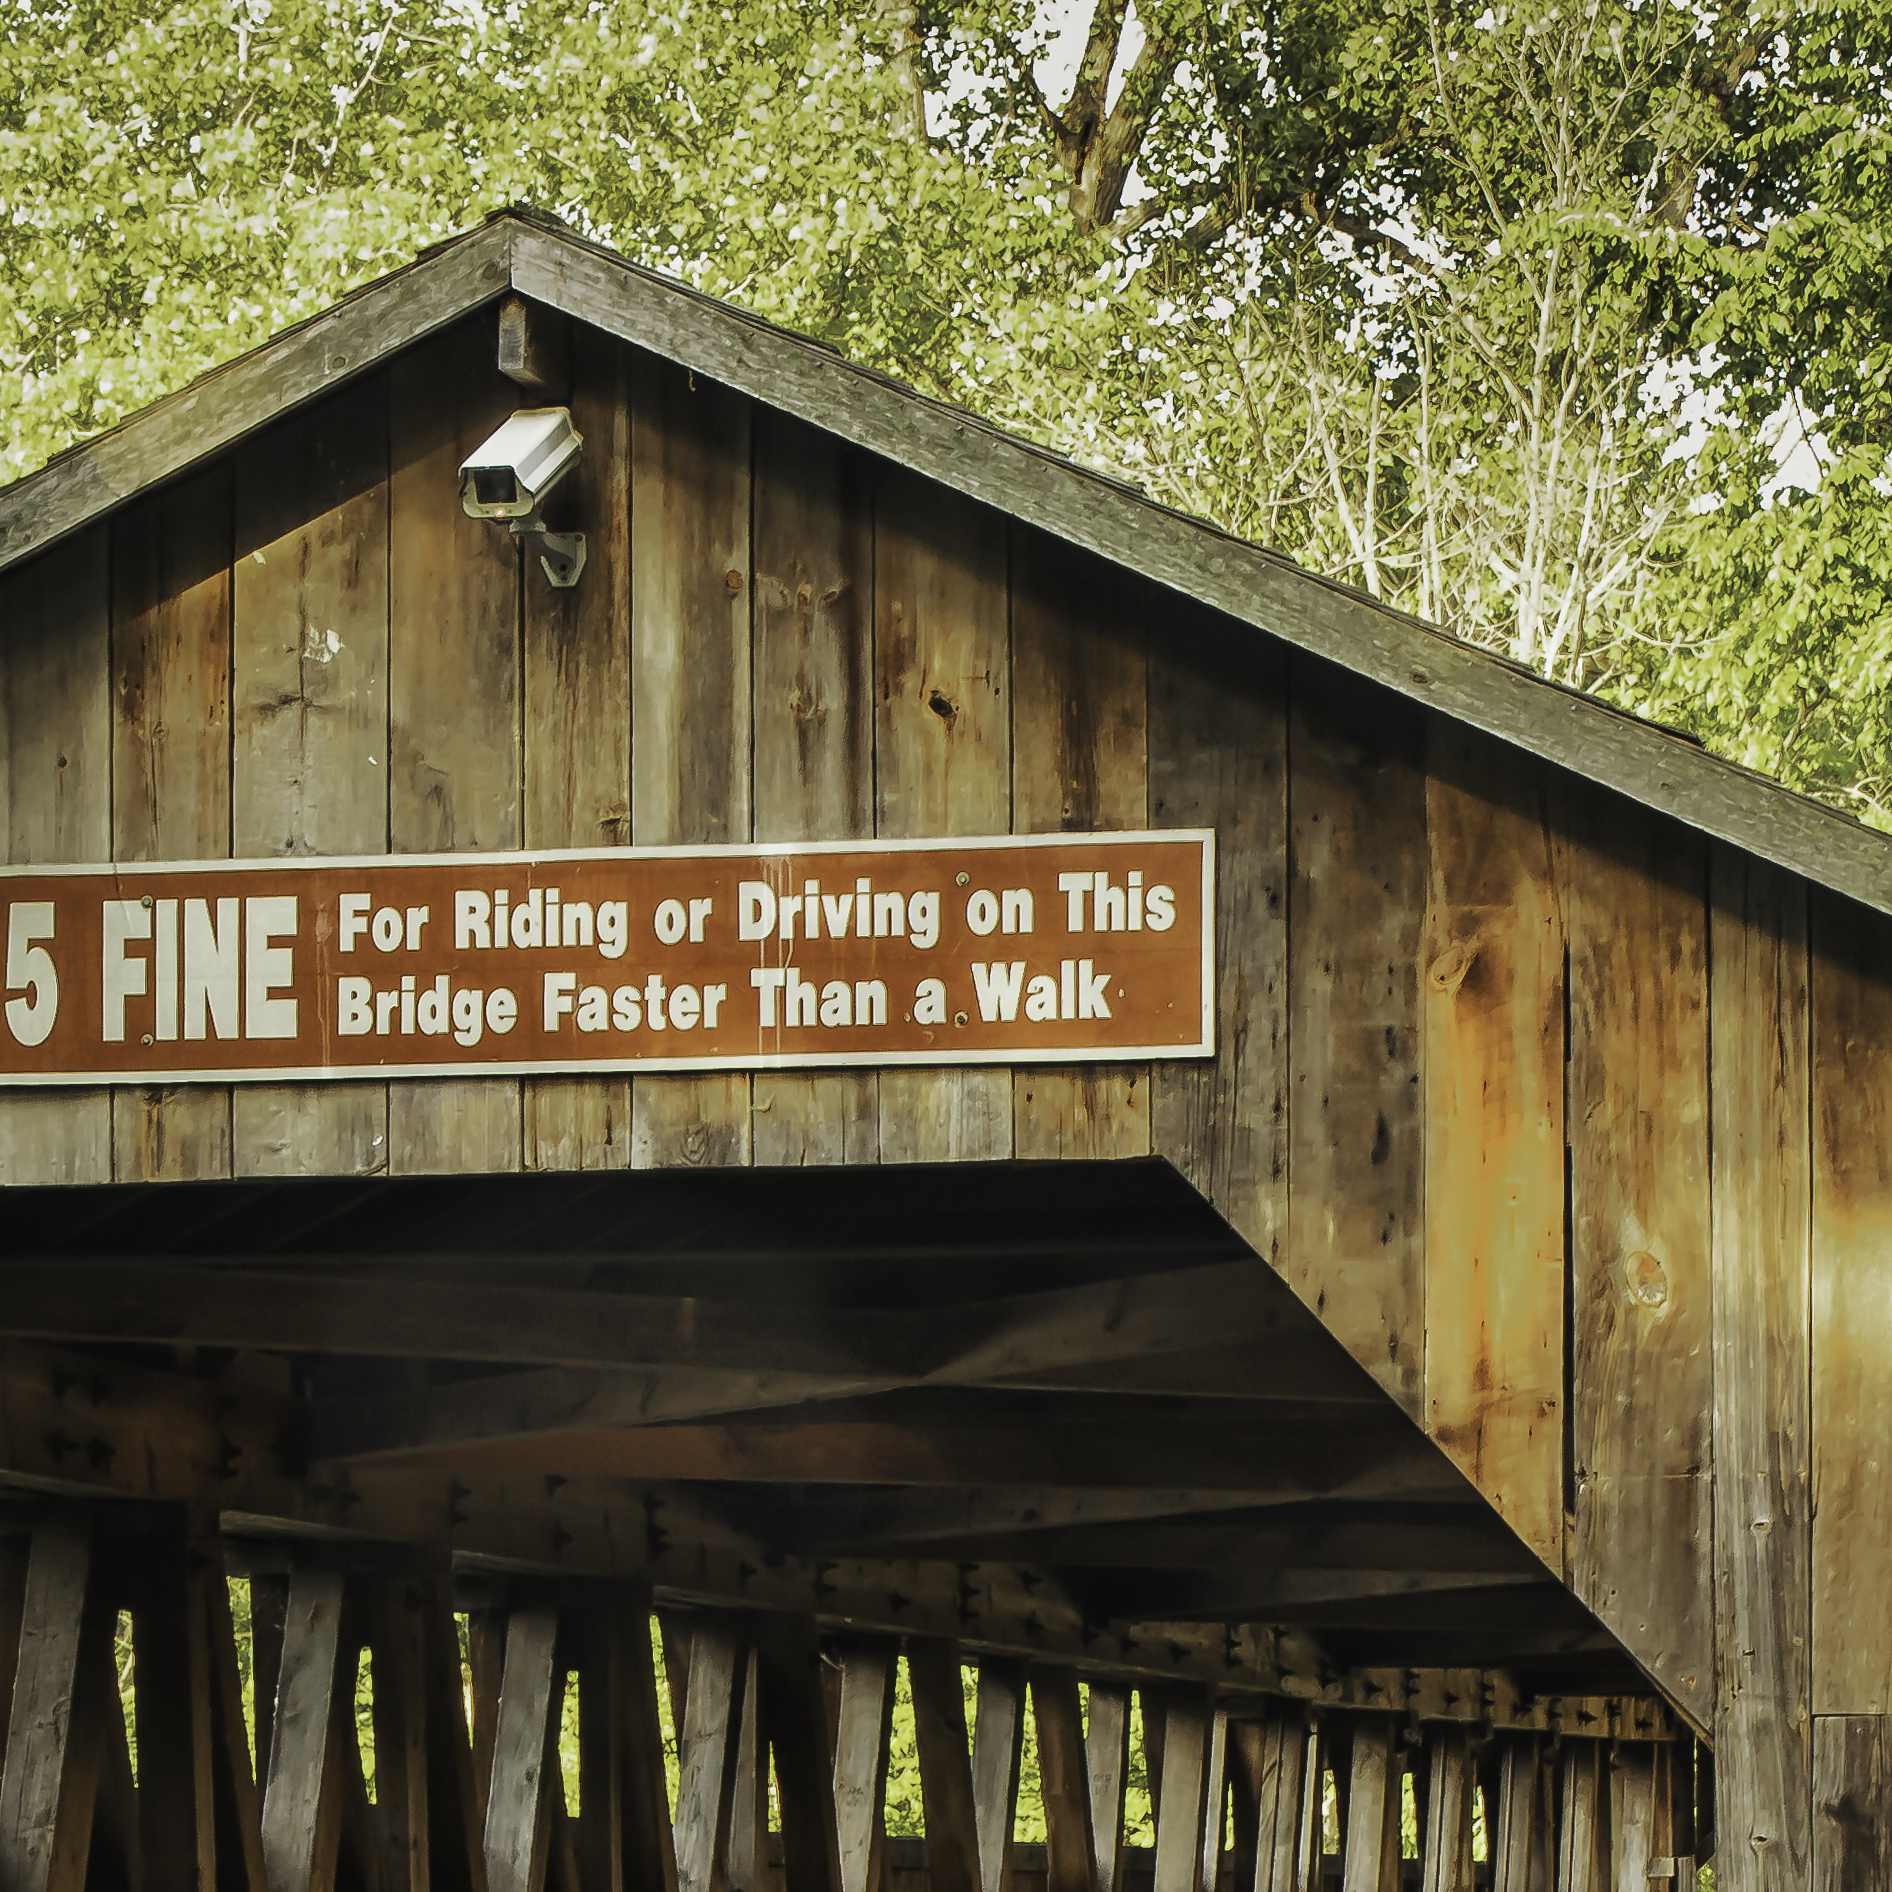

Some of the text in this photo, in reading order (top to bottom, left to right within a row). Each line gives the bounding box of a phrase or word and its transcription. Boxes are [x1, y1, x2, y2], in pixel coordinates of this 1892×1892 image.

[338, 869, 1177, 960] For Riding or Driving on This
[101, 895, 299, 1042] FINE
[336, 958, 1113, 1048] Bridge Faster Than a Walk
